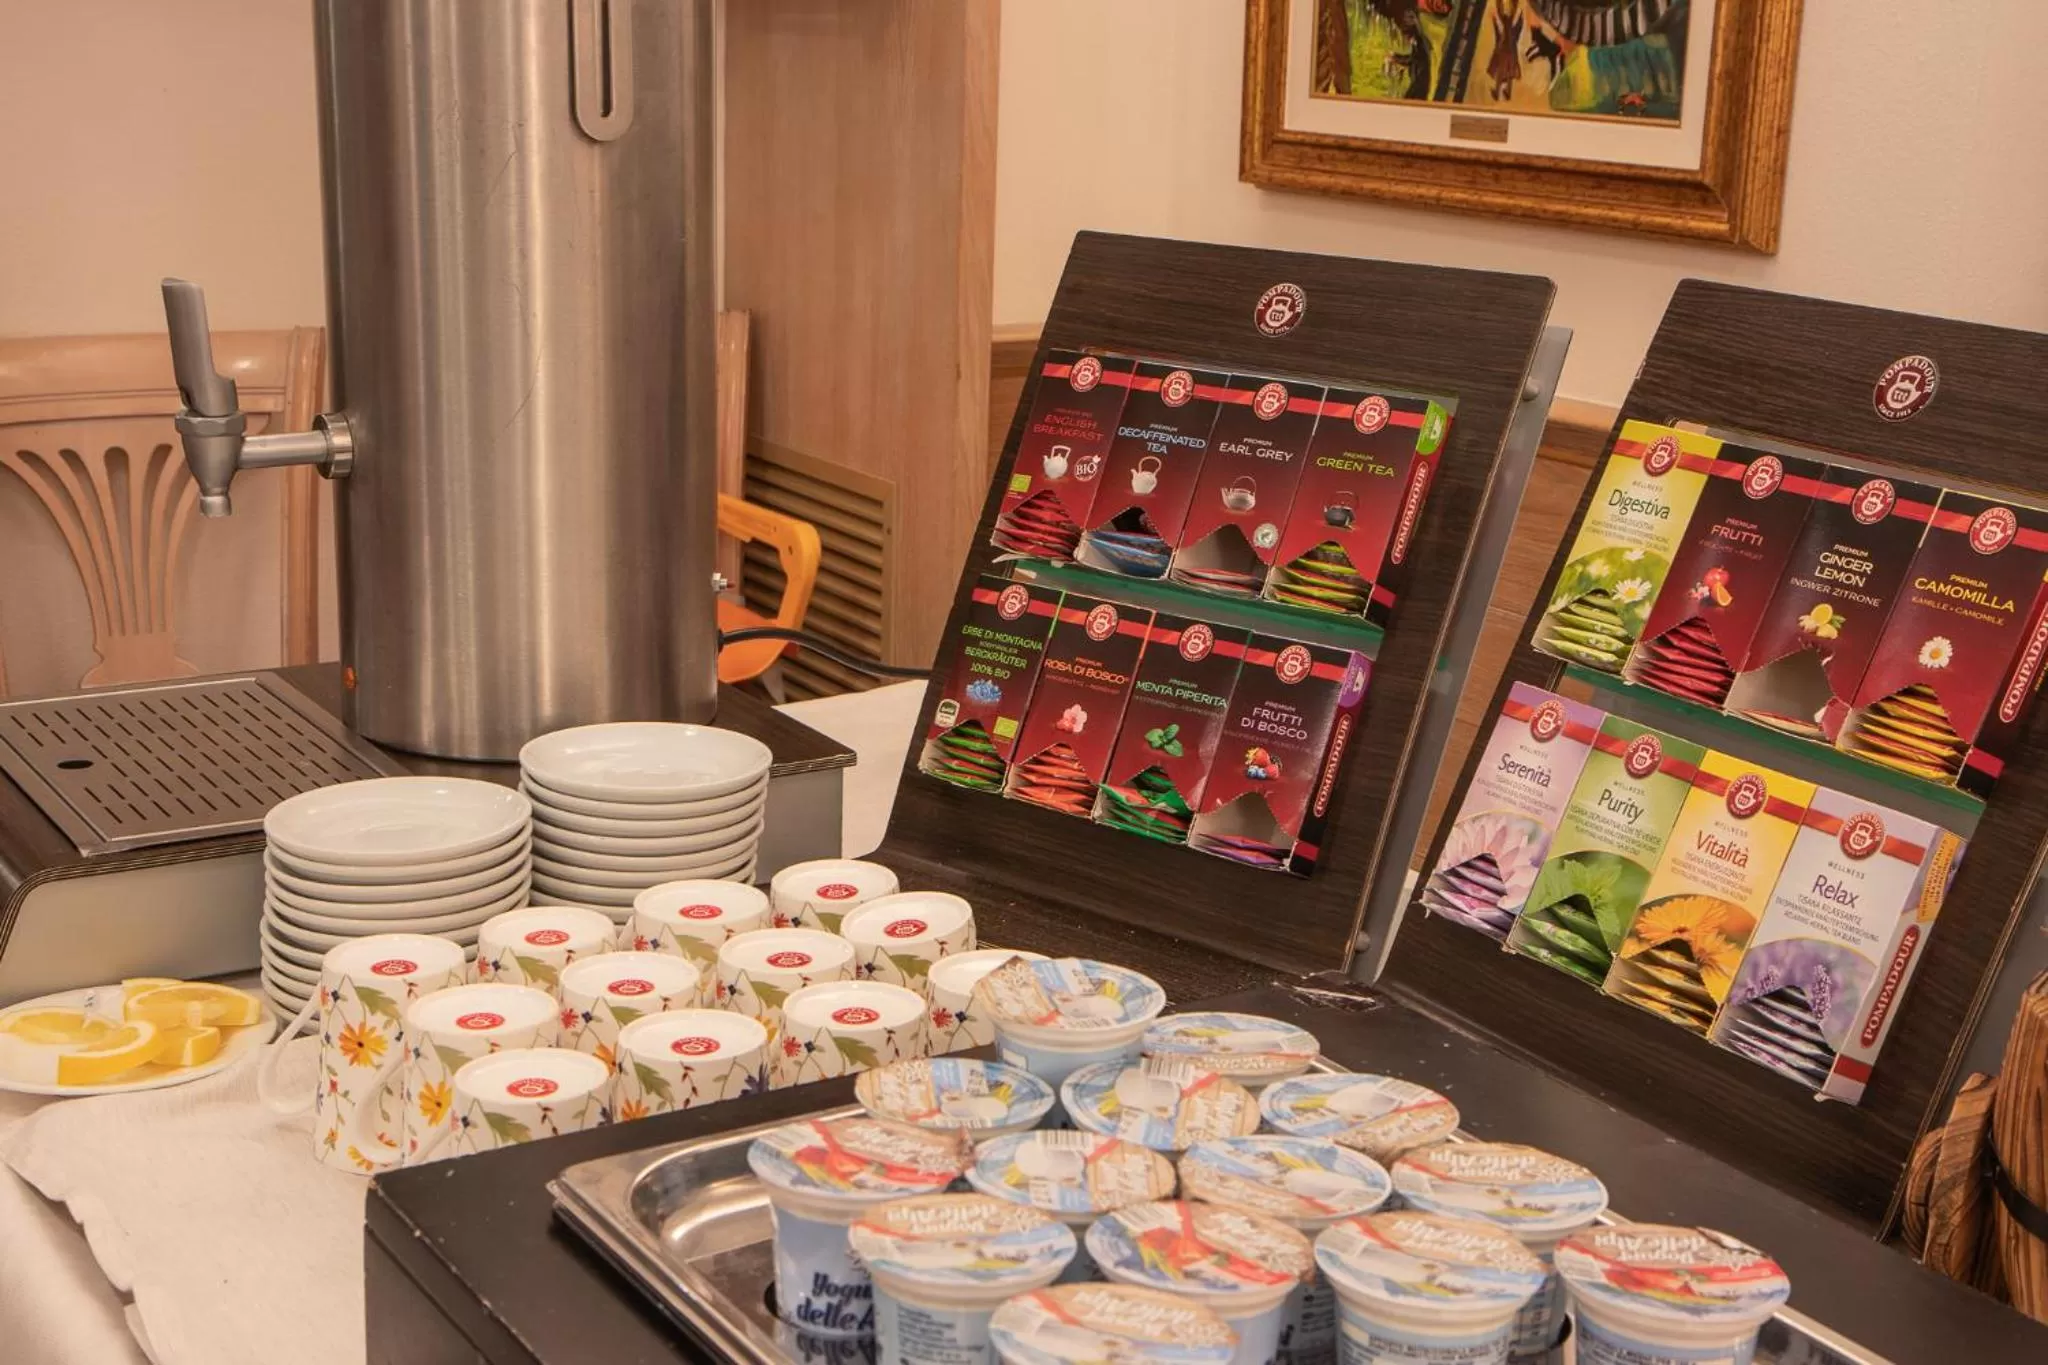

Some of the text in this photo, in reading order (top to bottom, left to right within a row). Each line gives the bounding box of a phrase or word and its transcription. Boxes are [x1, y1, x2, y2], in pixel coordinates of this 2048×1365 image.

[1257, 285, 1305, 313] POMPADOUR
[1879, 357, 1935, 393] POMPADOUR
[1033, 424, 1104, 442] BREAKFAST
[1044, 413, 1098, 430] ENGLISH
[1118, 426, 1206, 449] DECAFFEINATED
[1146, 442, 1168, 454] TEA
[1219, 442, 1294, 463] EARL GREY
[1075, 461, 1098, 477] BIO
[1316, 456, 1395, 477] GREEN TEA
[1608, 488, 1671, 521] Digestiva
[1710, 524, 1764, 547] FRUTTI
[1820, 551, 1873, 575] GINGER
[1833, 544, 1868, 558] PREMIUM
[1815, 566, 1866, 588] LEMON
[1950, 574, 1988, 589] PREMIUM
[1790, 577, 1881, 607] INGWER ZITRONE
[1914, 577, 2015, 613] CAMOMILLA
[995, 631, 1044, 652] MONTAGNA
[1044, 658, 1073, 674] ROSA
[1073, 664, 1087, 677] DI
[2004, 614, 2048, 716] POMPADO
[1136, 680, 1175, 697] MENTA
[1175, 687, 1228, 709] PIPERITA
[1240, 717, 1255, 730] DI
[1257, 721, 1308, 741] BOSCO
[1252, 707, 1303, 727] FRUTTI
[1498, 752, 1552, 788] Serenità
[1598, 788, 1645, 825] Purity
[1696, 829, 1749, 869] Vitalità
[1827, 861, 1865, 880] WELLNESS
[1812, 874, 1860, 909] Relax
[1863, 935, 1917, 1040] POMPADOUR
[812, 1271, 872, 1306] Yogu
[796, 1297, 858, 1331] delle
